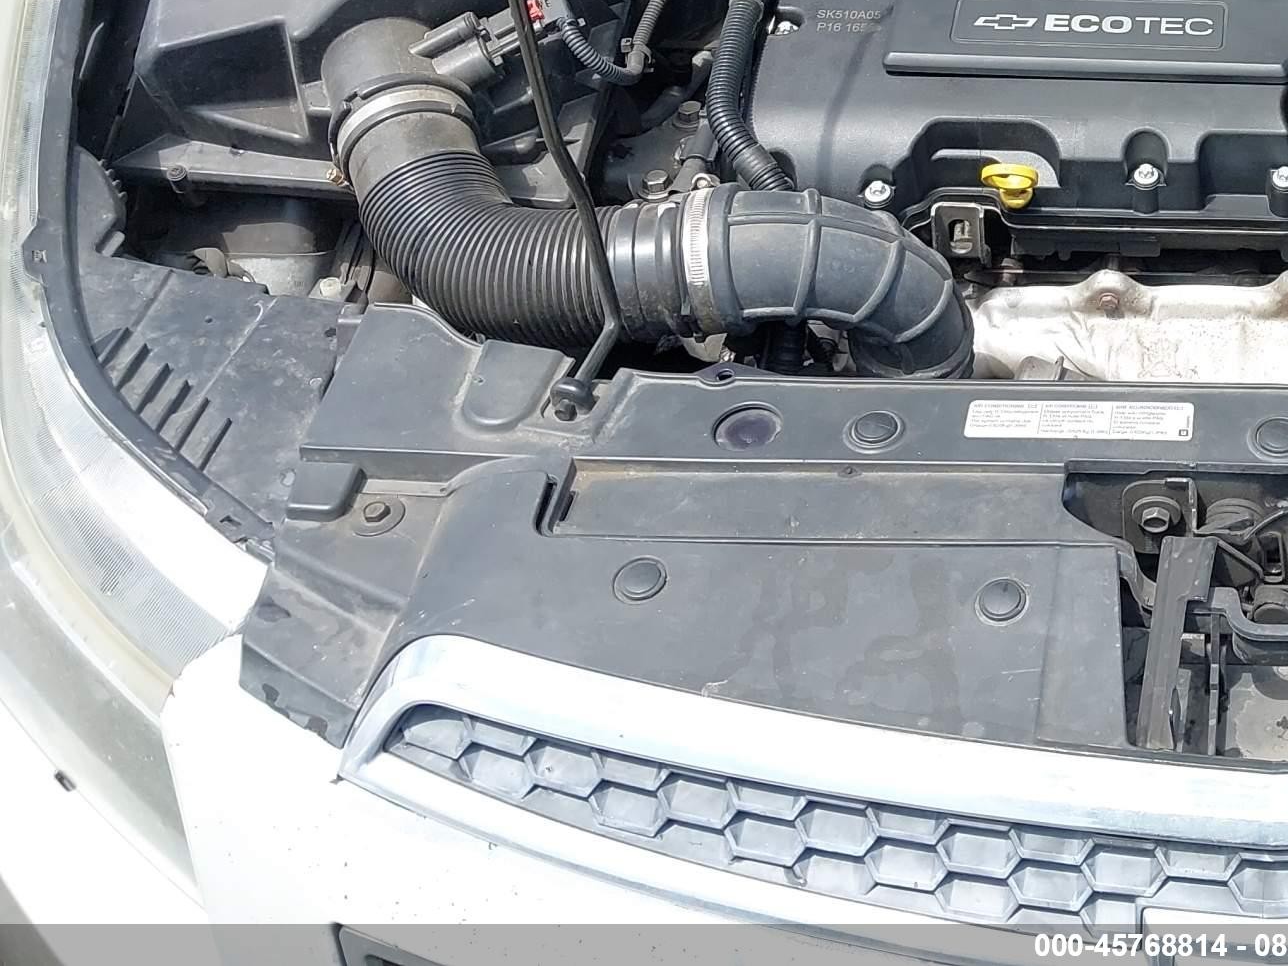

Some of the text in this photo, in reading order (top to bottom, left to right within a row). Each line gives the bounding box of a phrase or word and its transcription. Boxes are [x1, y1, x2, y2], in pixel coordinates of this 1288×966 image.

[816, 9, 881, 20] SK510A05
[816, 22, 842, 32] P16
[1044, 14, 1214, 36] ECOTEC
